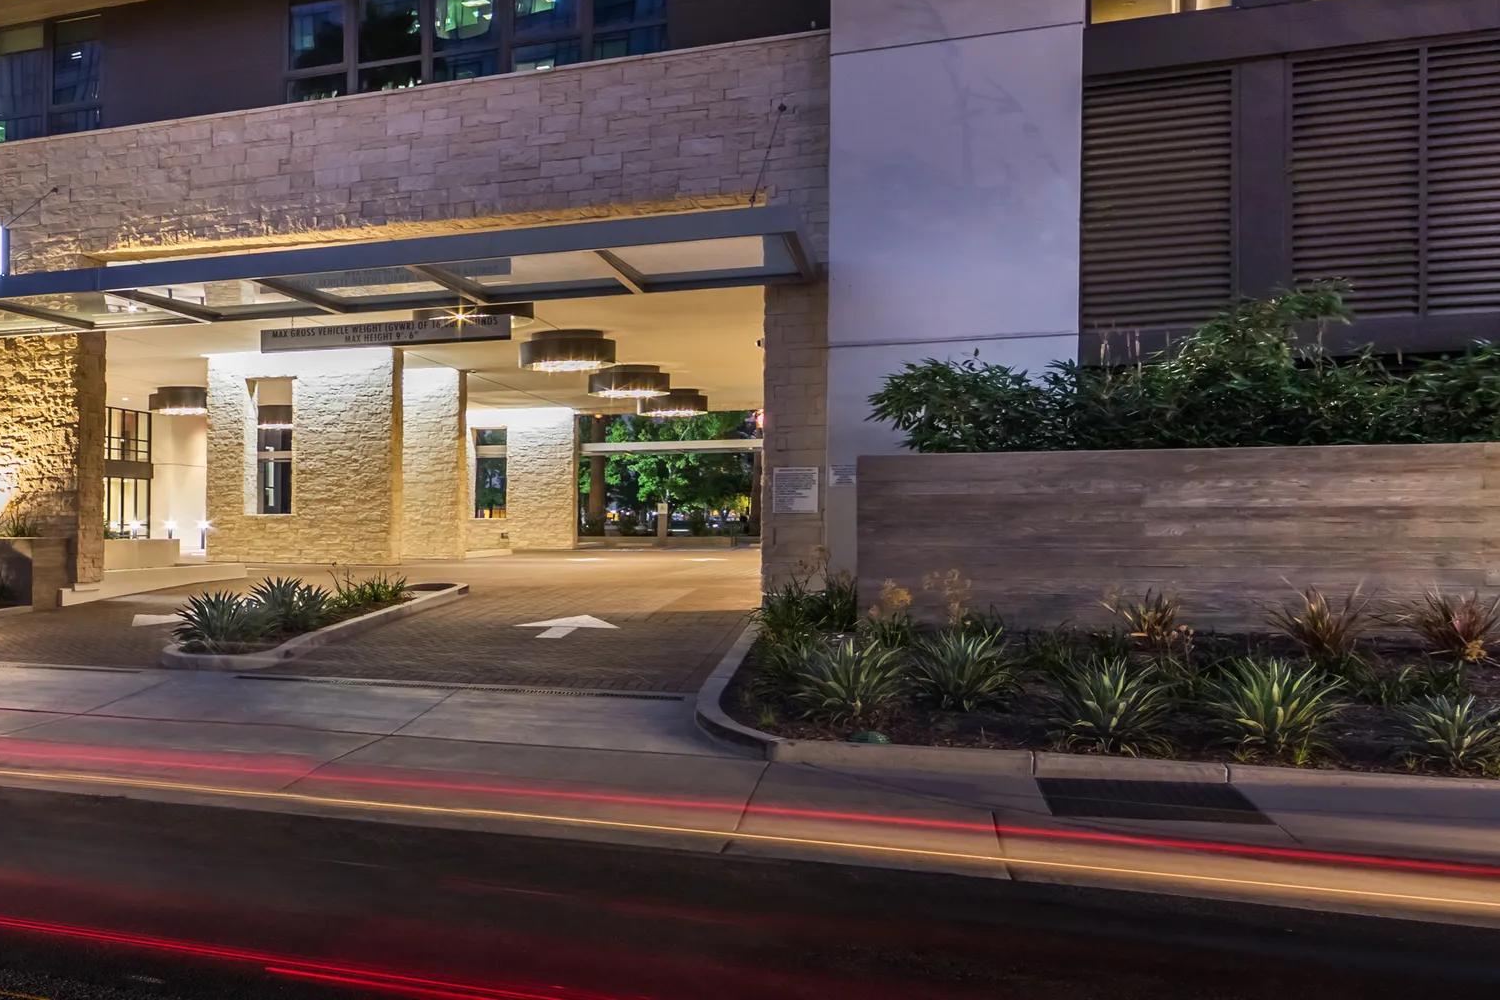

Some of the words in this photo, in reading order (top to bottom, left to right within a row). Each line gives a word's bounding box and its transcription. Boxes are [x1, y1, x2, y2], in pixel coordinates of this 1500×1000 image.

[272, 330, 288, 338] MAX
[291, 328, 316, 337] GROSS
[318, 326, 349, 336] VEHICLE
[352, 324, 384, 333] WEIGHT
[417, 321, 428, 330] OF
[345, 334, 360, 342] MAX
[364, 332, 392, 341] HEIGHT
